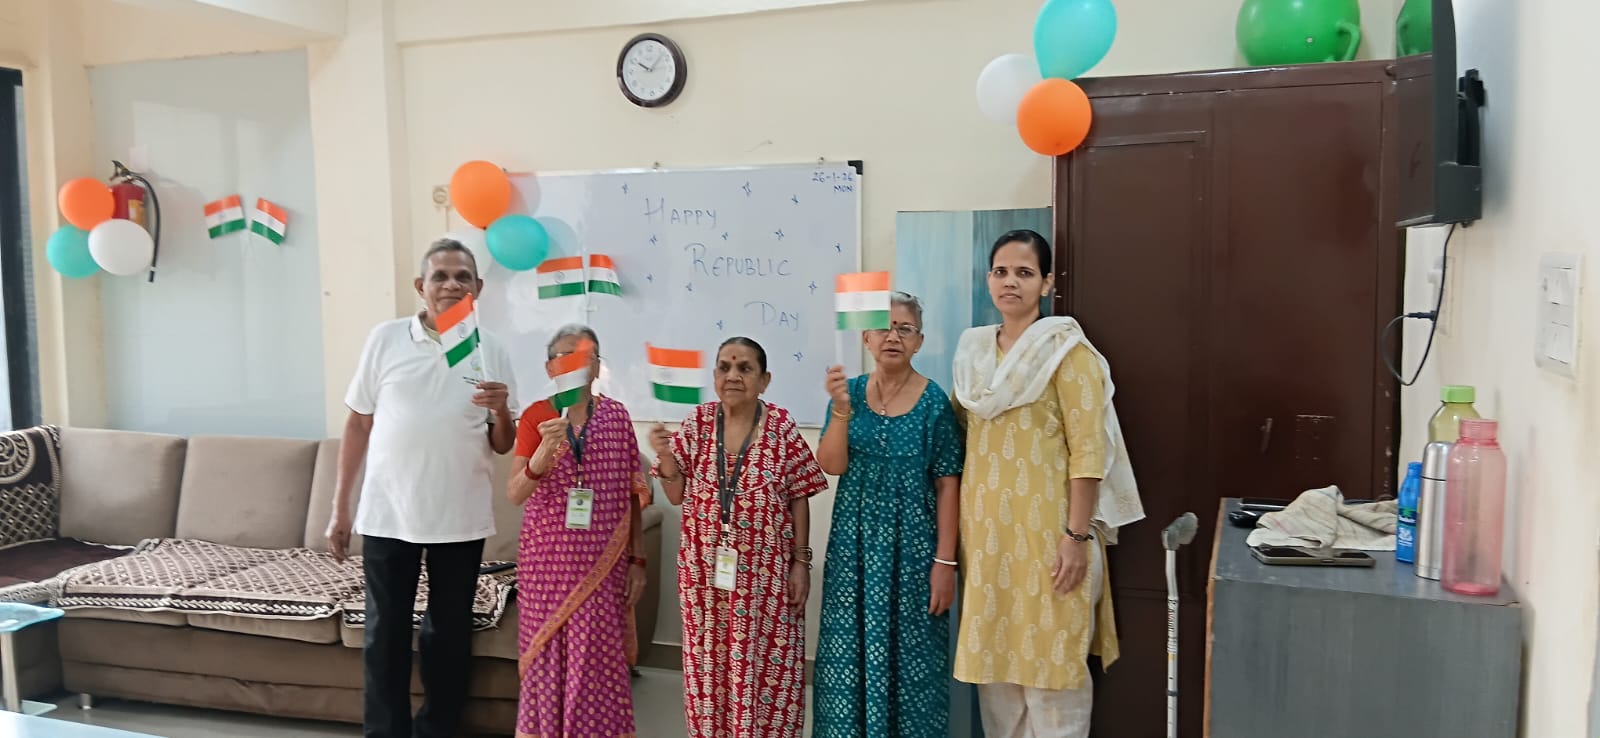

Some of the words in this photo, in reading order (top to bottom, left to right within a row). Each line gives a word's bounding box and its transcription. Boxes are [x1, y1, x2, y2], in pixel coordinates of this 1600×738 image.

[643, 197, 717, 229] HAPPY
[684, 243, 792, 277] REPUBLIC
[744, 300, 800, 331] DAY
